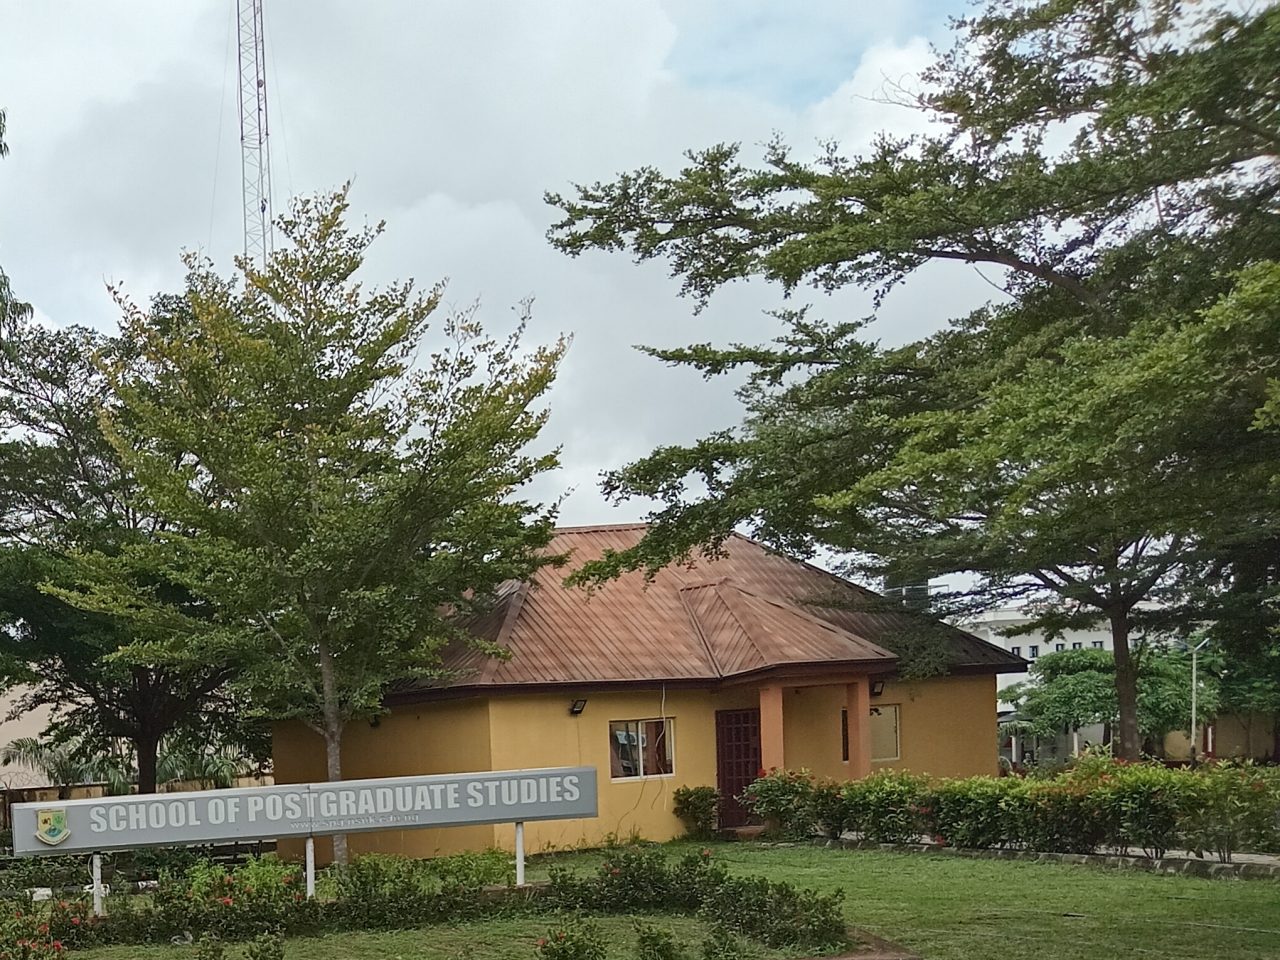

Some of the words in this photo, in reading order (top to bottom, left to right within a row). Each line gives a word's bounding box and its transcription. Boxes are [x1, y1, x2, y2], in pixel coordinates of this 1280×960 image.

[89, 799, 201, 833] SCHOOL
[207, 797, 240, 826] OF
[247, 782, 461, 823] POSTGRADUATE
[466, 775, 581, 808] STUDIES
